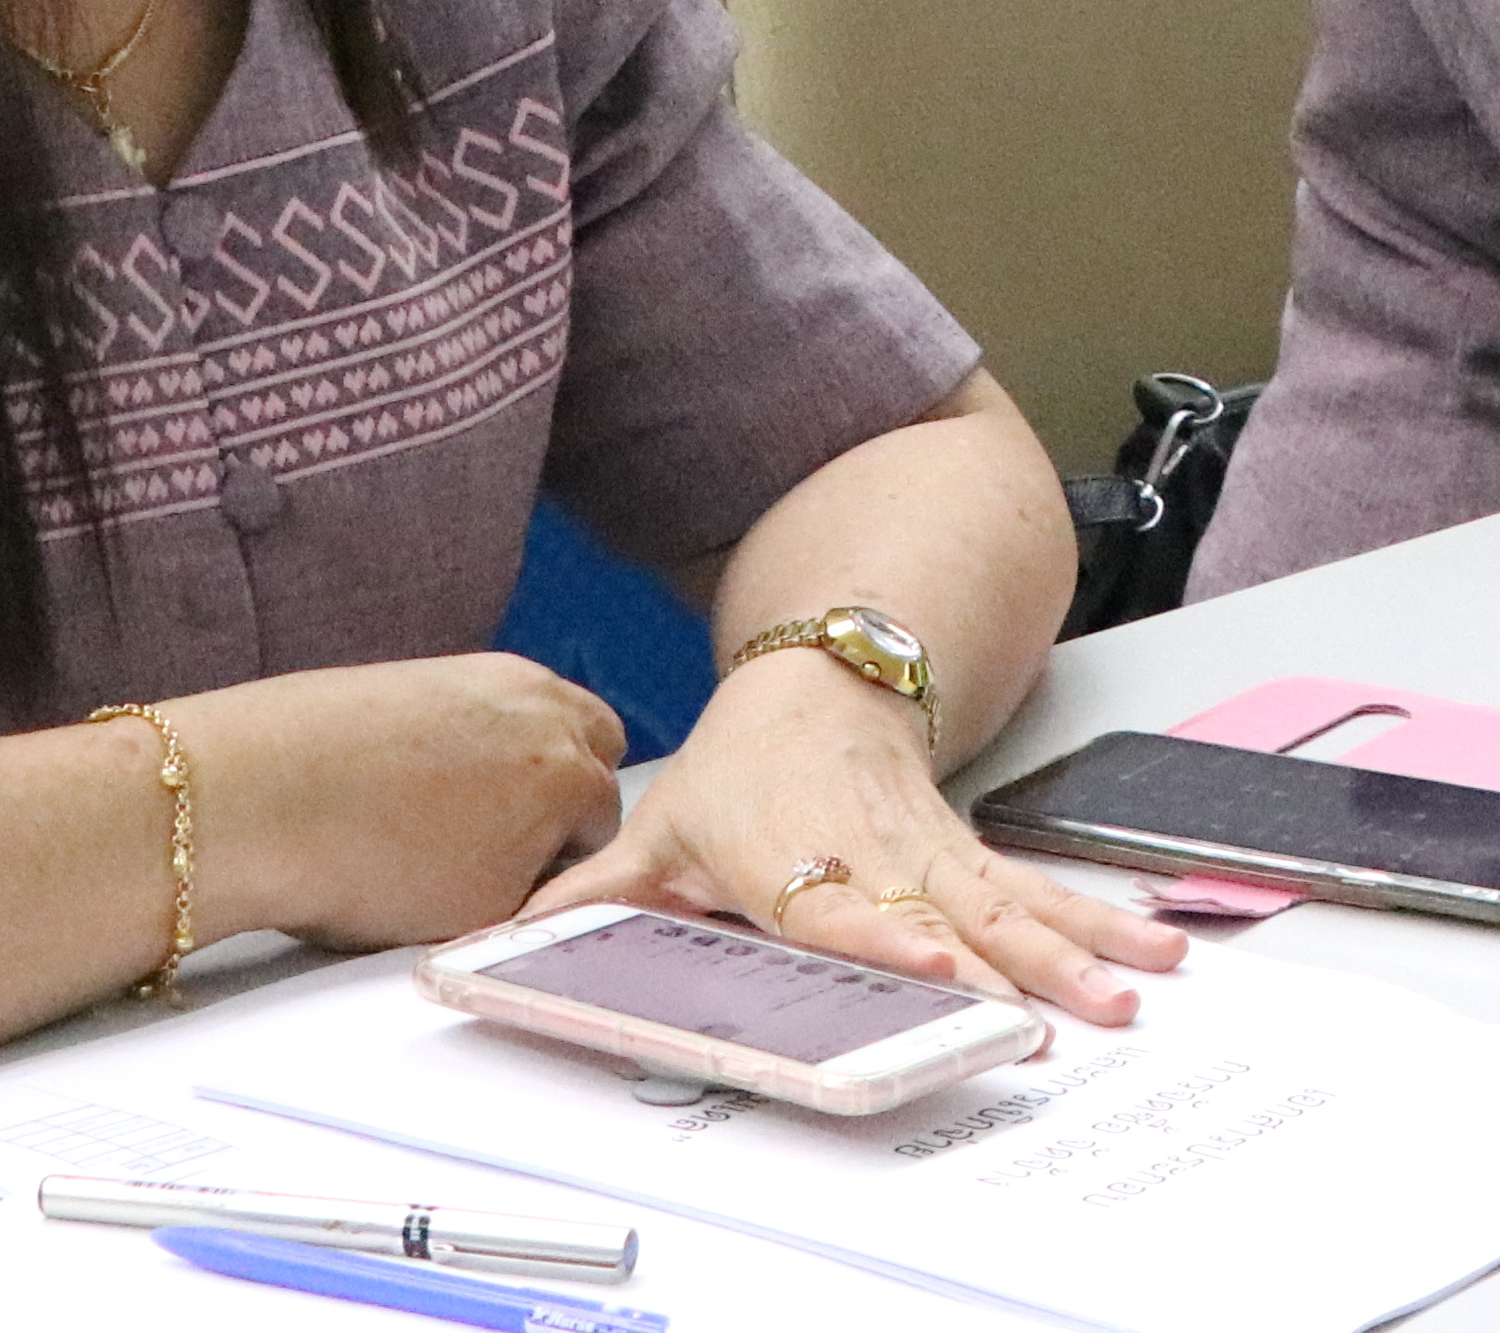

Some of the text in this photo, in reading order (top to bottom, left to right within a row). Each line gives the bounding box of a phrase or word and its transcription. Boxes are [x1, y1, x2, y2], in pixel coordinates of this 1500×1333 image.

[892, 1045, 1152, 1161] และการเบิกจ่าย
[1082, 1086, 1339, 1208] เอกสารประกอบ
